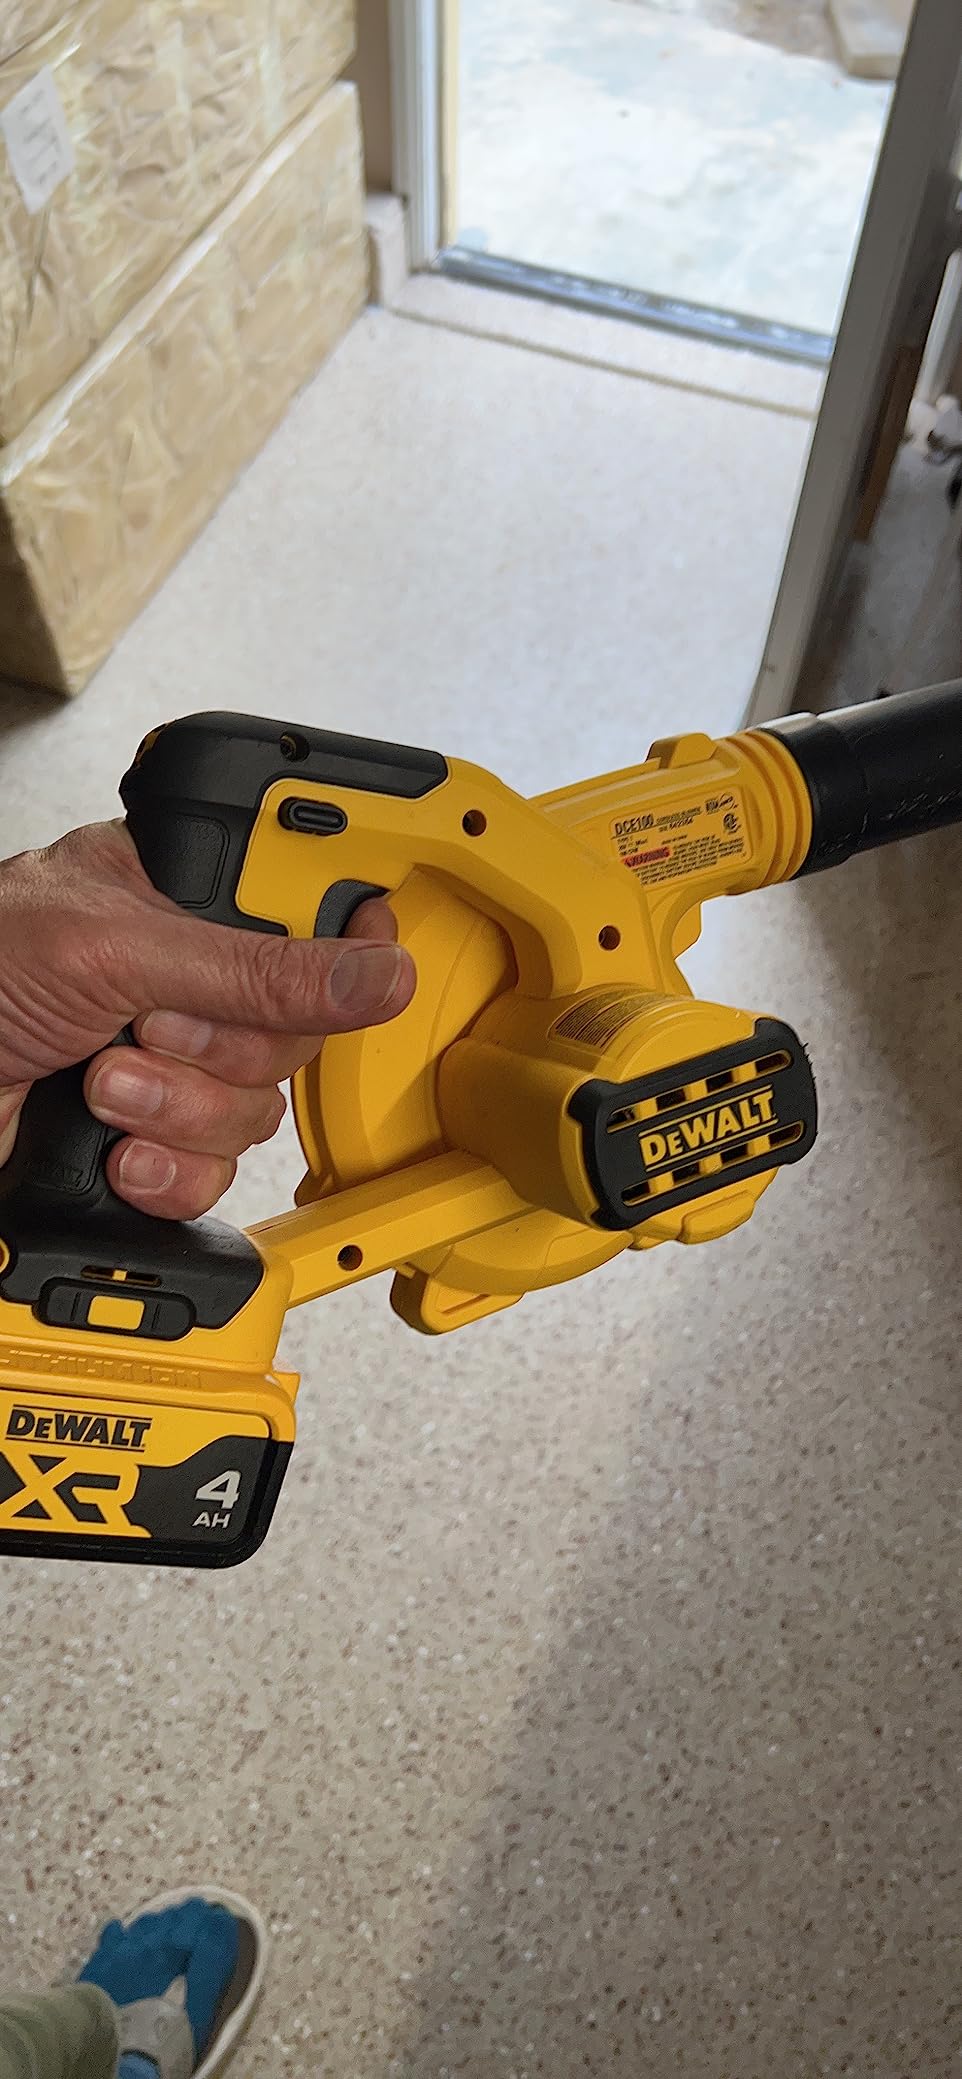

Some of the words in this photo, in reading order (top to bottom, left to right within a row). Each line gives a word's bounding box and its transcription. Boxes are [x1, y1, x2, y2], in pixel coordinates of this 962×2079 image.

[614, 813, 654, 836] DCE100
[638, 1089, 775, 1167] DEWALT
[6, 1408, 152, 1447] DEWALT
[0, 1451, 140, 1526] XR
[194, 1469, 242, 1510] 4
[192, 1511, 232, 1529] AH
